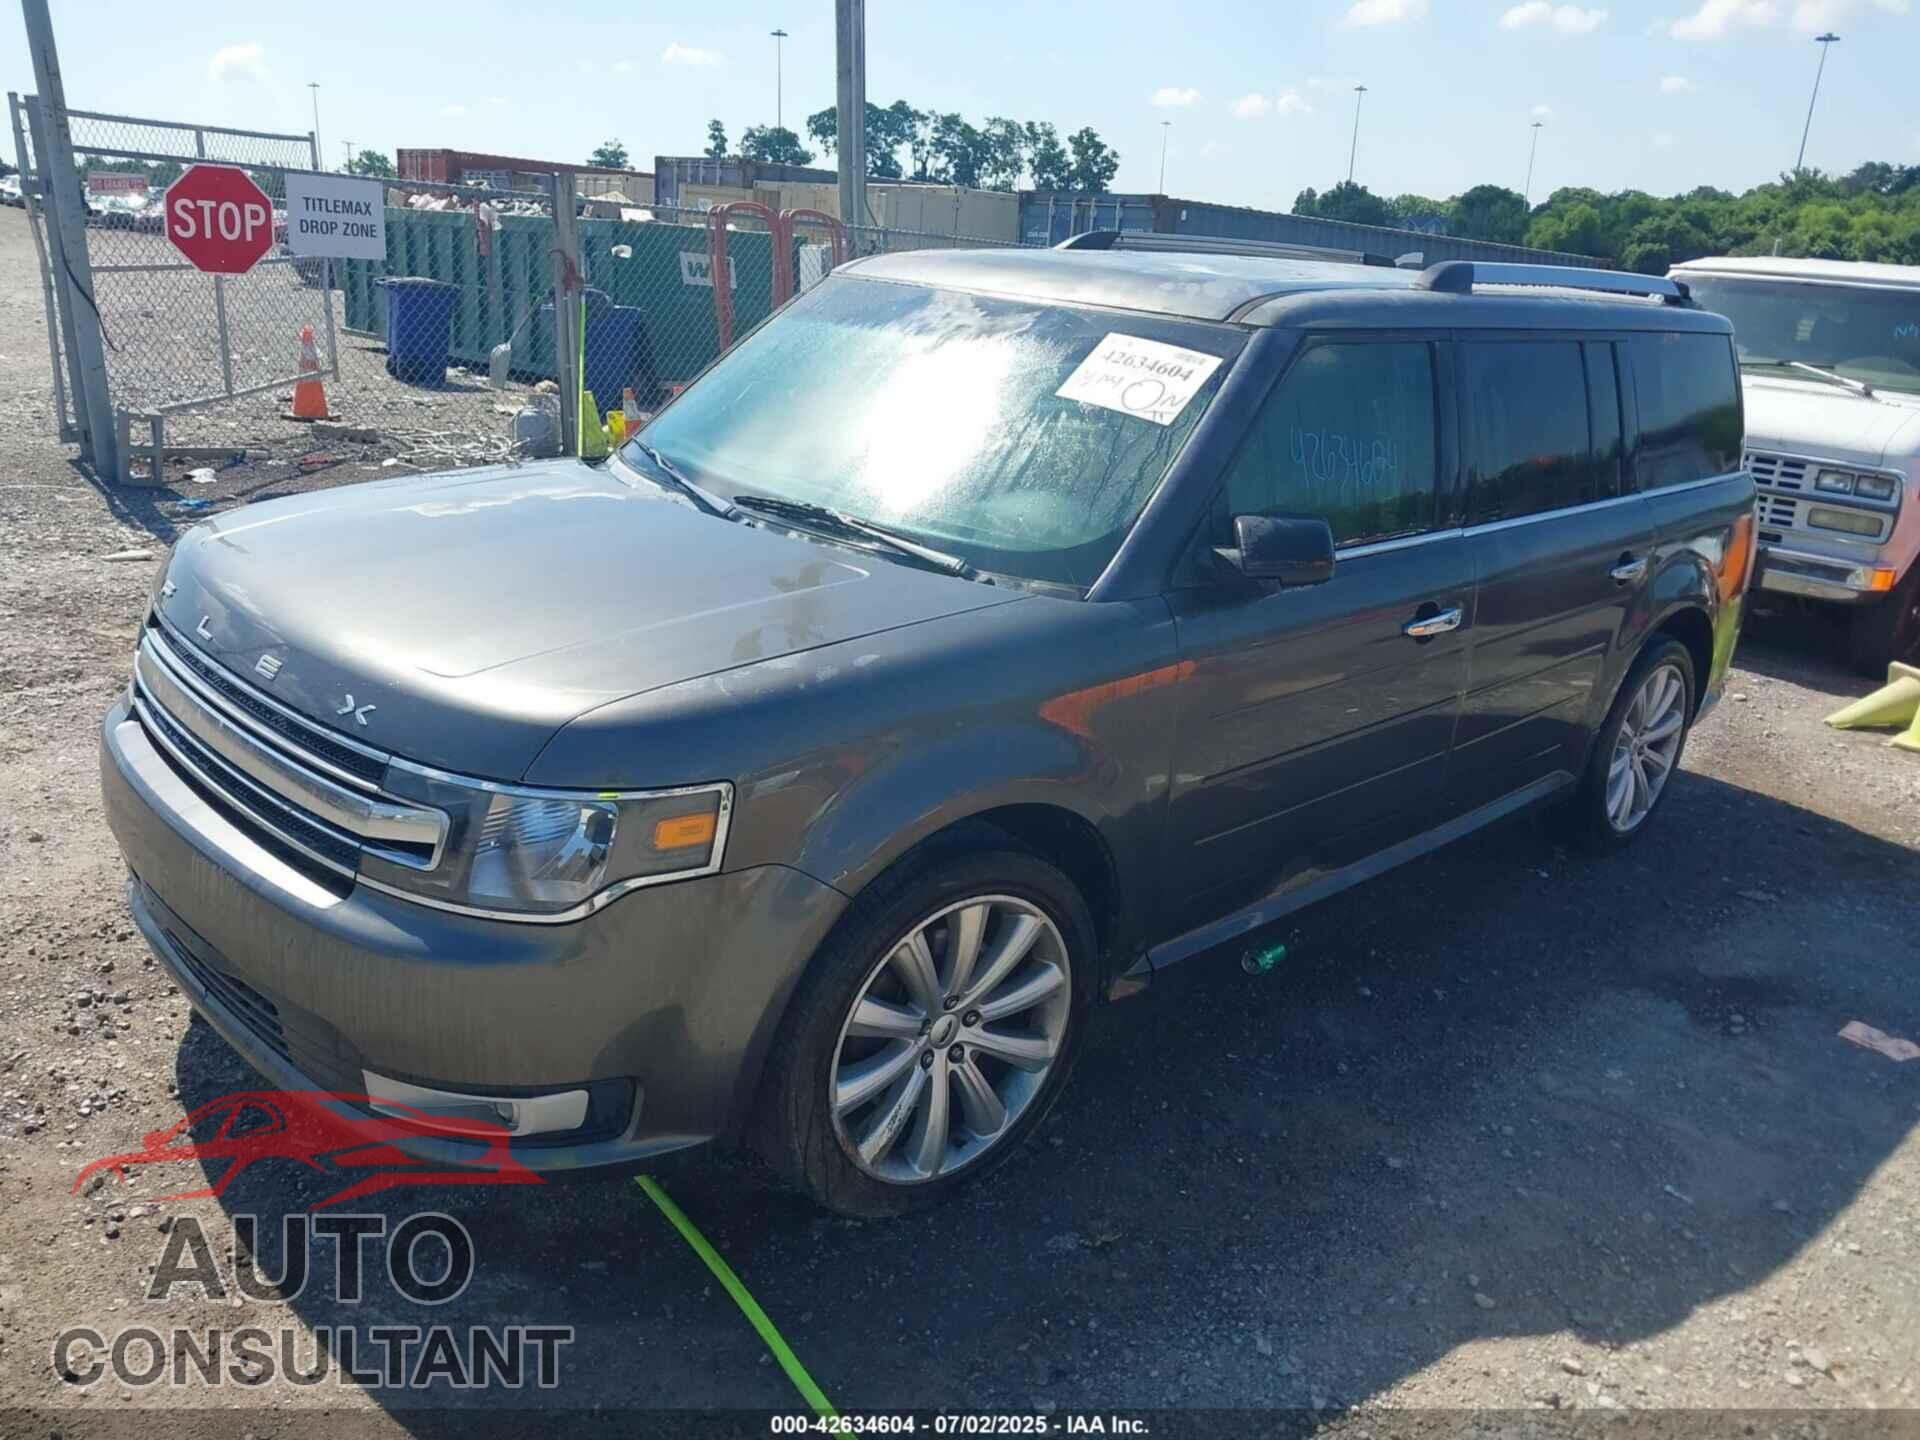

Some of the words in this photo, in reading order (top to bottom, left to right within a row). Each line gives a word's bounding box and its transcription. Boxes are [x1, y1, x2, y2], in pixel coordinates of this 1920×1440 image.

[174, 198, 266, 242] STOP
[302, 196, 373, 217] TITLEMAX
[300, 218, 338, 236] DROP
[342, 221, 378, 239] ZONE
[160, 578, 377, 726] FLEX
